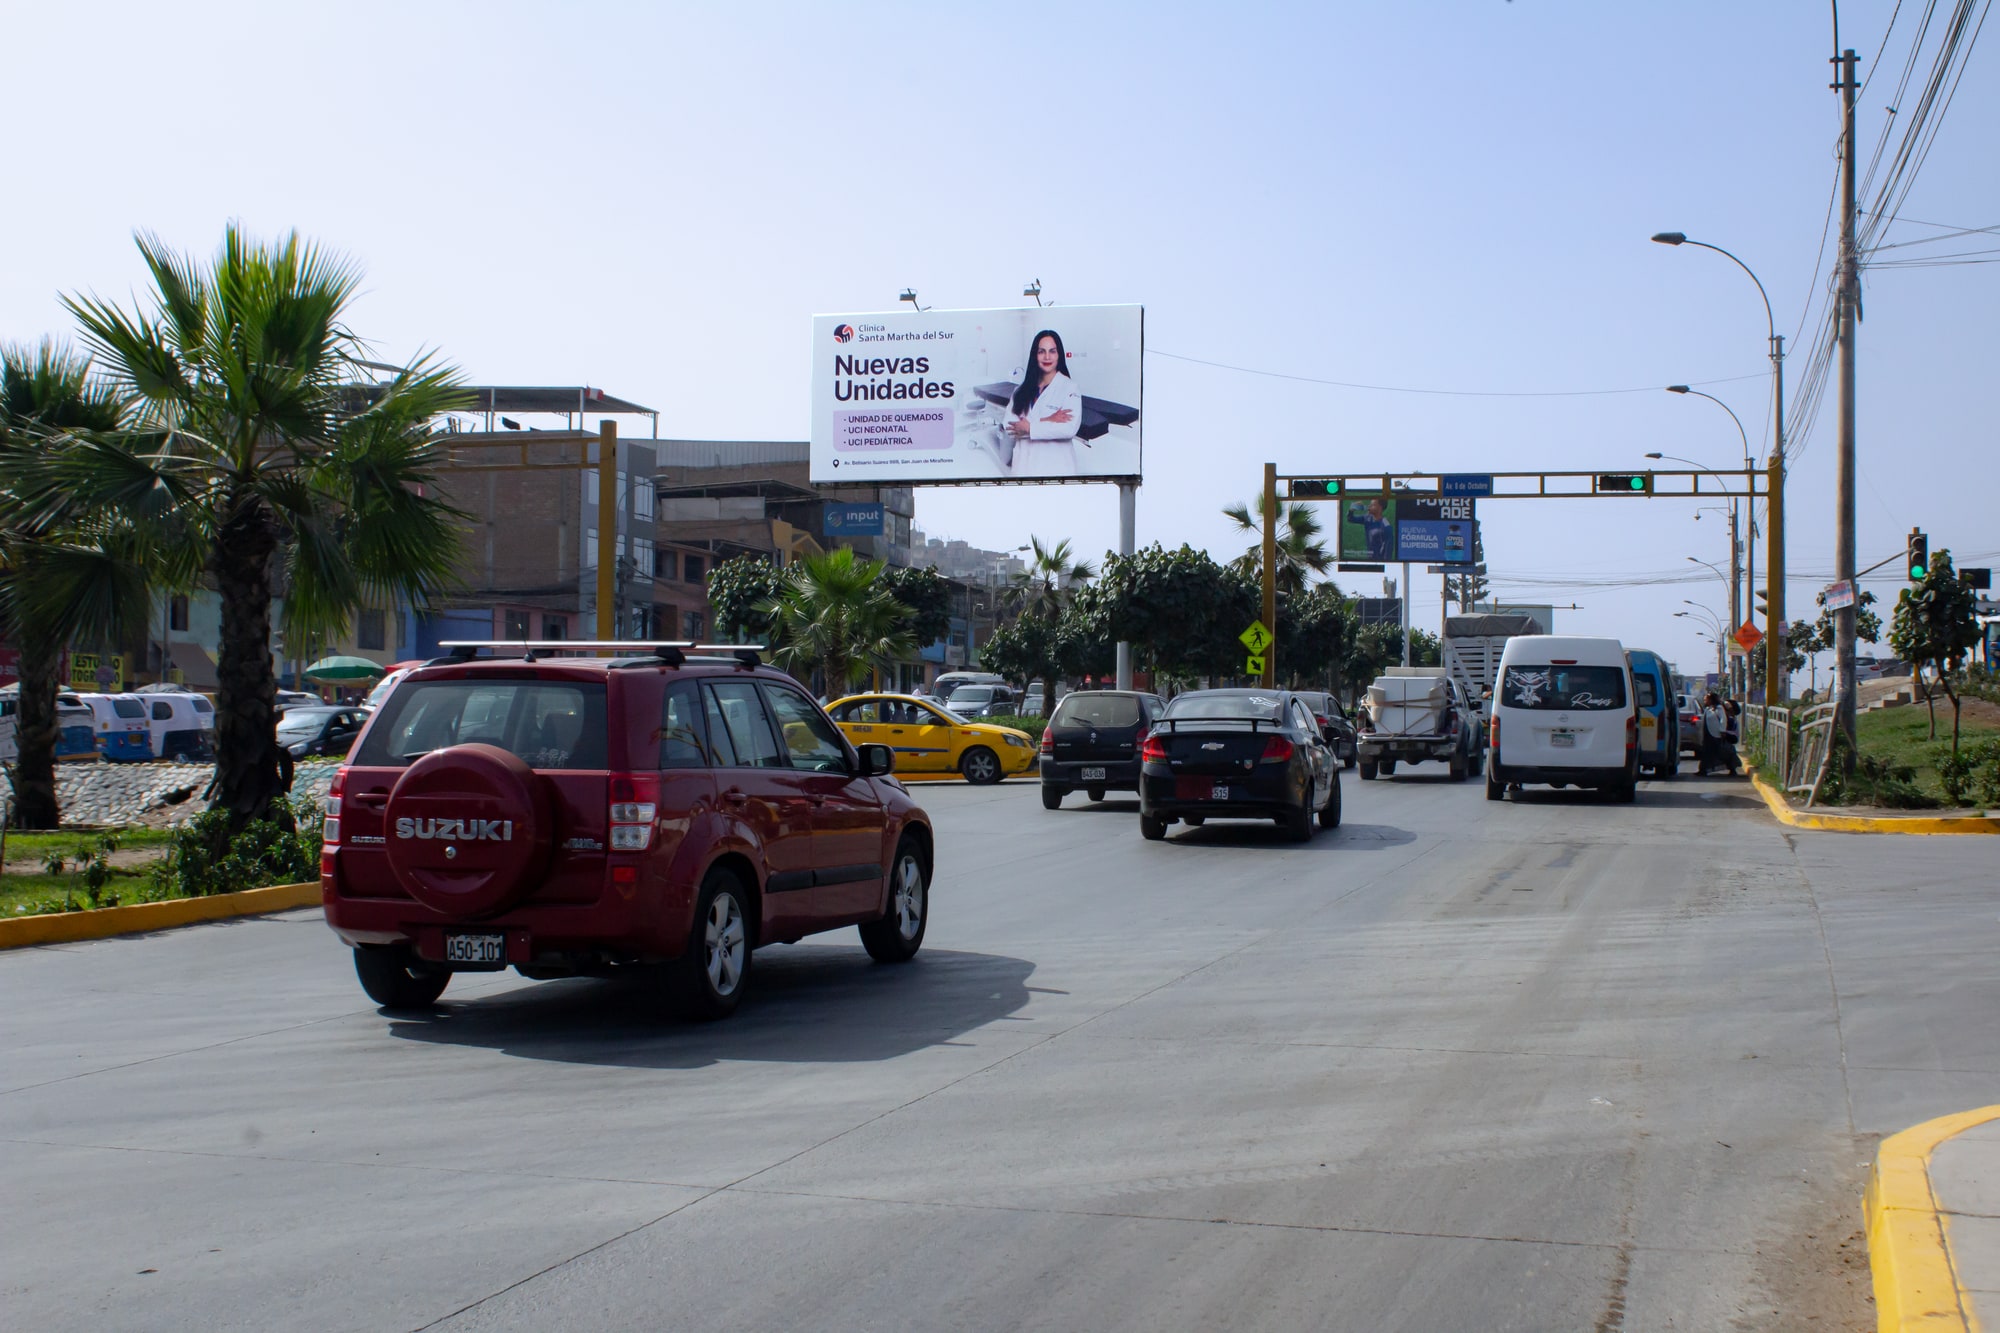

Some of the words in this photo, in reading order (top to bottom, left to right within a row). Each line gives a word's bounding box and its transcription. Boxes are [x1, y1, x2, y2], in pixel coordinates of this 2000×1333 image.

[858, 334, 885, 342] Santa
[887, 332, 920, 341] Martha
[922, 331, 937, 340] del
[938, 331, 954, 339] Sur
[835, 354, 930, 376] Nuevas
[835, 377, 955, 402] Unidades
[848, 414, 880, 423] UNIDAD
[881, 414, 893, 422] DE
[894, 413, 944, 422] QUEMADOS
[848, 426, 863, 434] UCI
[864, 425, 908, 433] NEONATAL
[848, 438, 863, 446] UCI
[864, 436, 913, 445] PEDIÁTRICA
[846, 510, 880, 523] input
[1440, 506, 1471, 519] ADE
[1401, 541, 1439, 549] SUPERIOR
[395, 817, 513, 841] SUZUKI
[448, 940, 502, 961] A50-101
